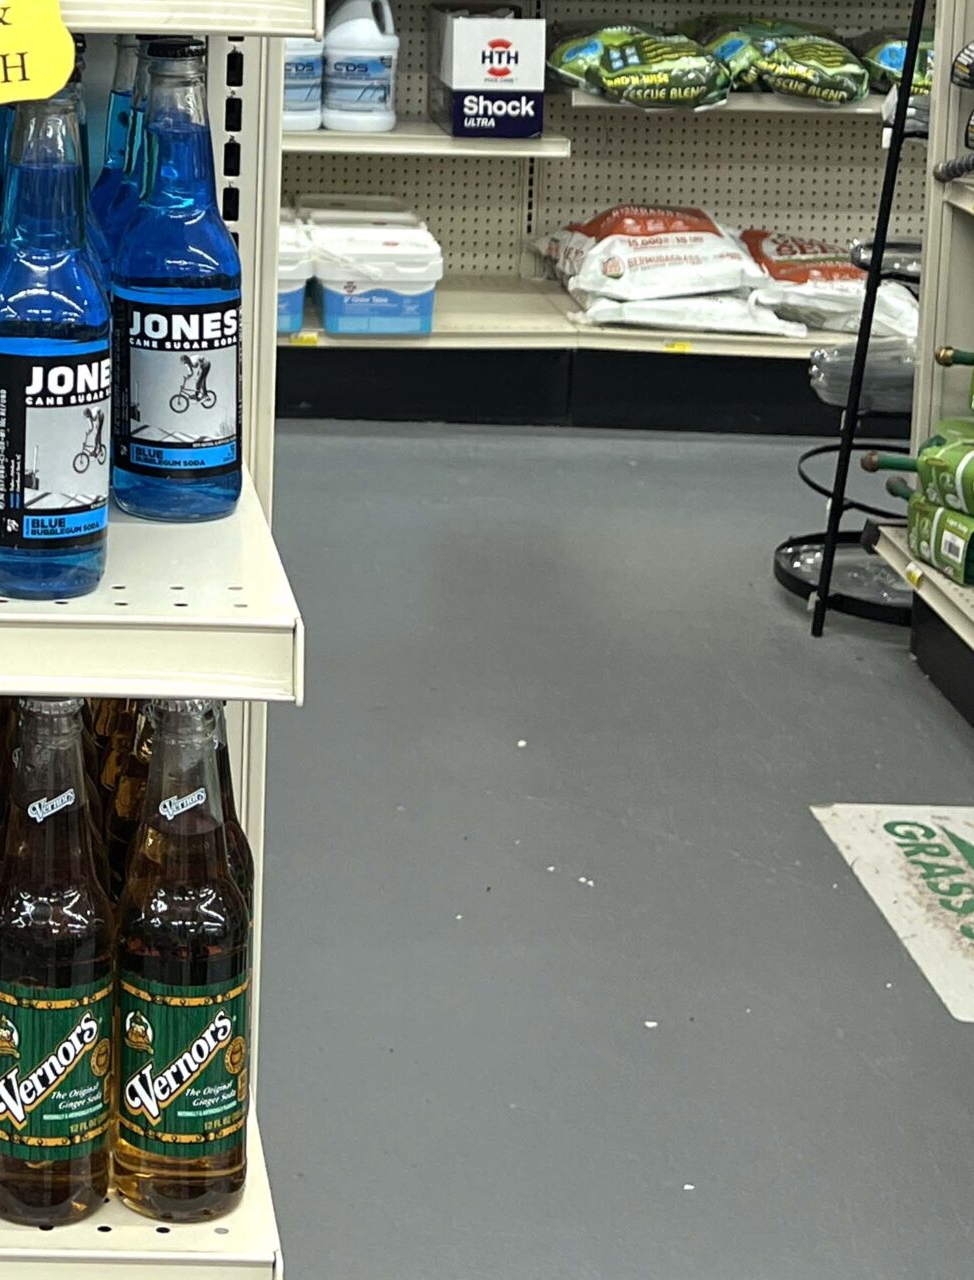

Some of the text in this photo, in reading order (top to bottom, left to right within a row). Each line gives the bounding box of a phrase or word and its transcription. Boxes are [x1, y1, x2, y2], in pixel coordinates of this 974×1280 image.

[482, 50, 519, 65] HTH
[623, 85, 707, 101] FESCUE BLEND
[808, 85, 848, 101] BLEND
[463, 95, 535, 116] Shock
[463, 117, 495, 128] ULTRA
[129, 309, 238, 342] JONES
[129, 338, 208, 350] CANE SUGAR
[26, 392, 102, 406] CANE SUGAR
[31, 517, 66, 528] BLUE
[126, 1011, 232, 1119] Vernors
